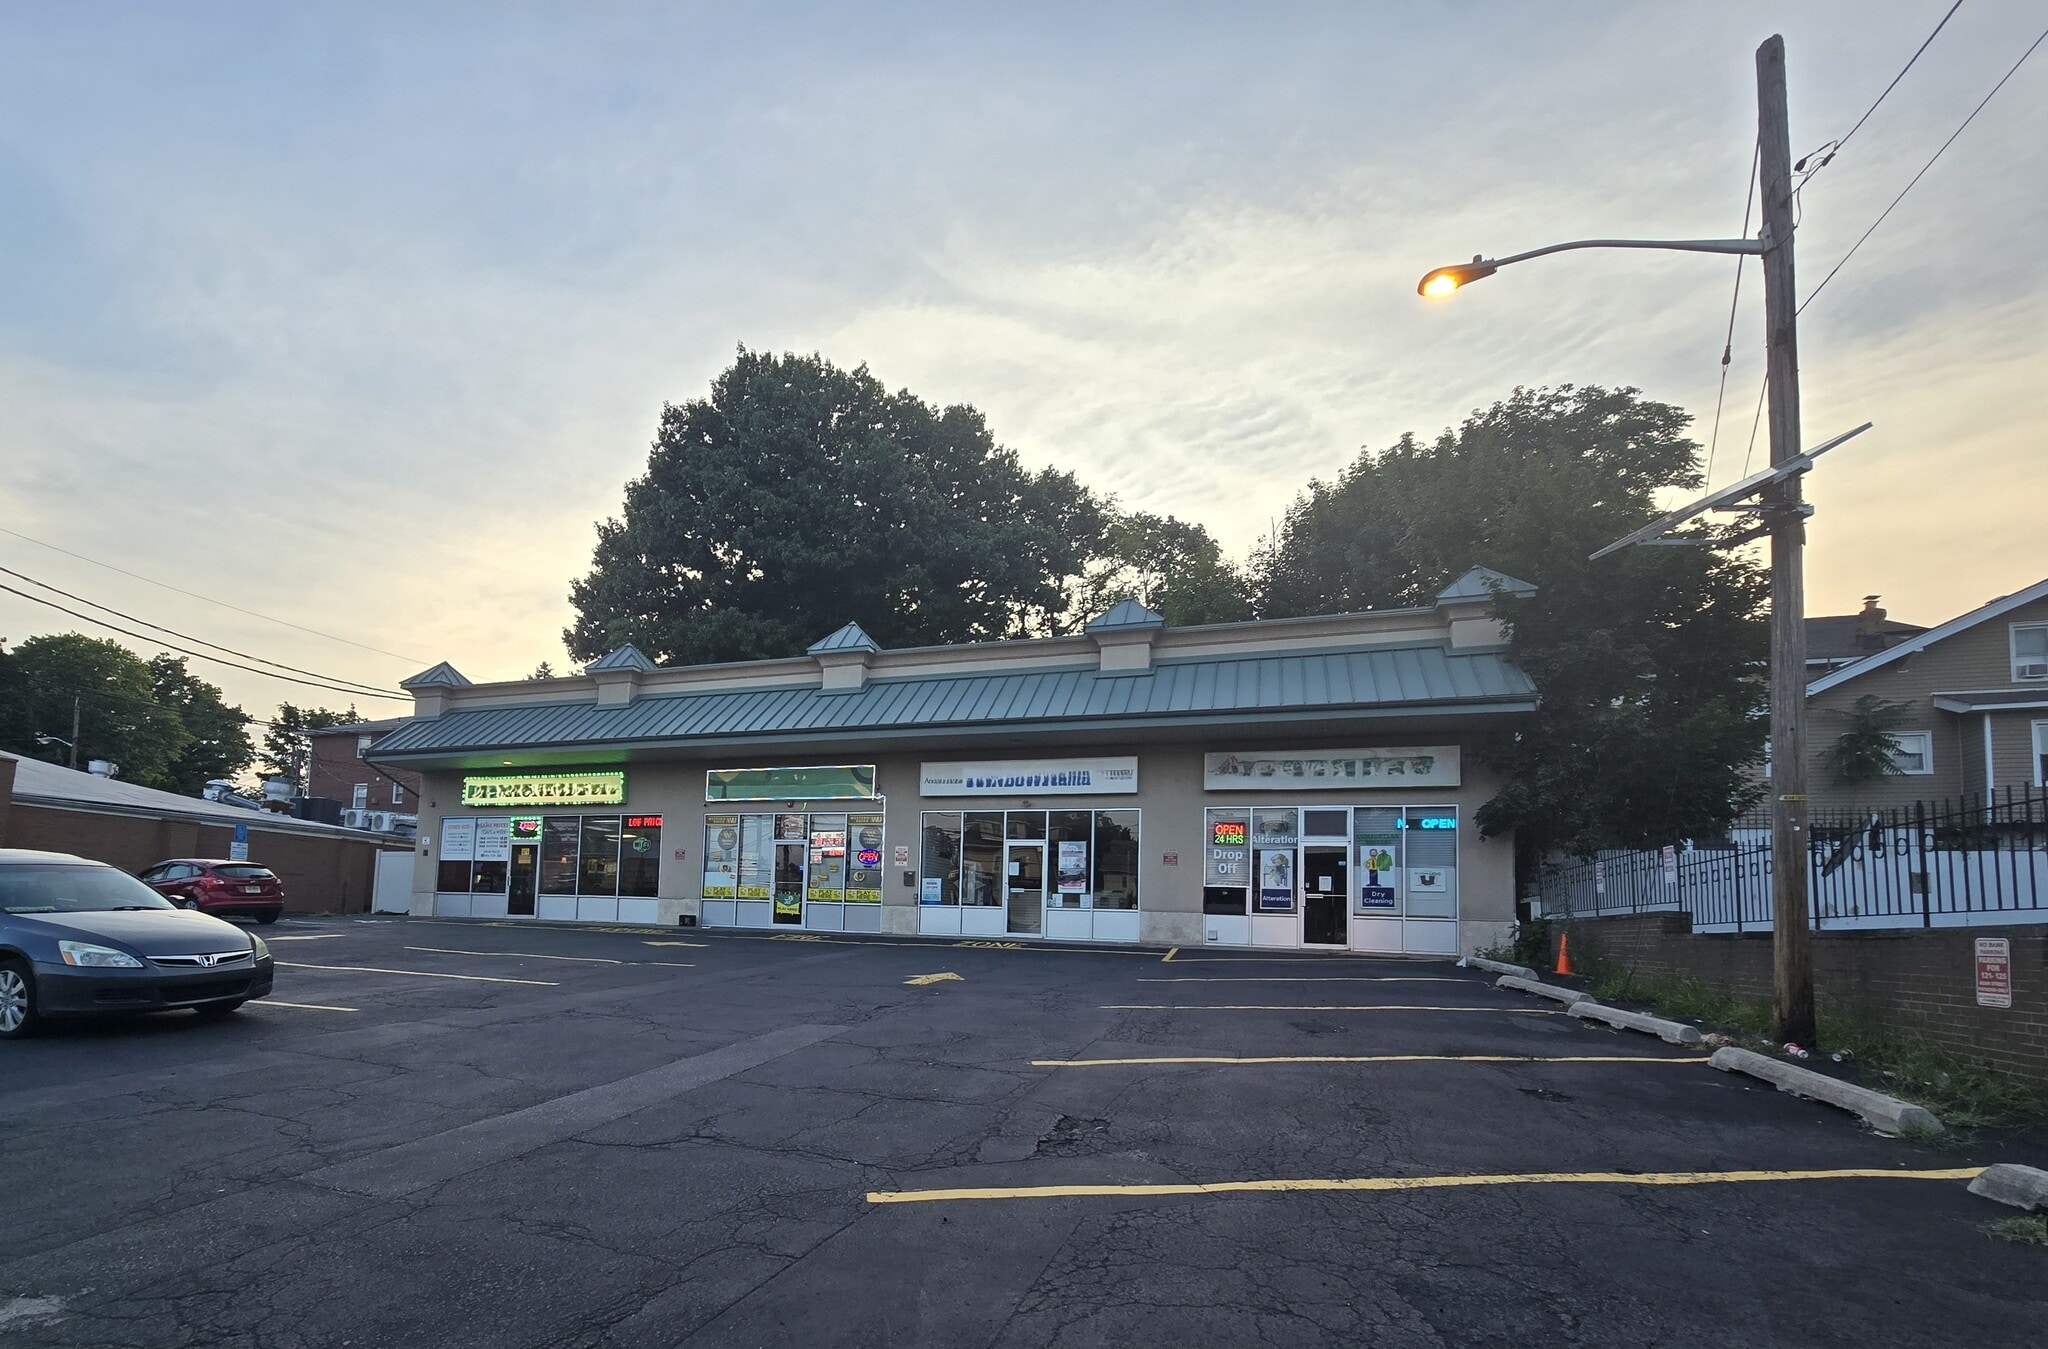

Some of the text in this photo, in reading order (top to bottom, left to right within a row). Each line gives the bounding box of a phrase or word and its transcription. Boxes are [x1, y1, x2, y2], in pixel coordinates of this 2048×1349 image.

[1421, 818, 1456, 829] OPEN
[1215, 825, 1244, 835] OPEN
[1214, 834, 1244, 844] 24 HRS
[858, 852, 879, 862] OPEN
[1213, 849, 1243, 861] Drop
[1218, 863, 1238, 874] Off
